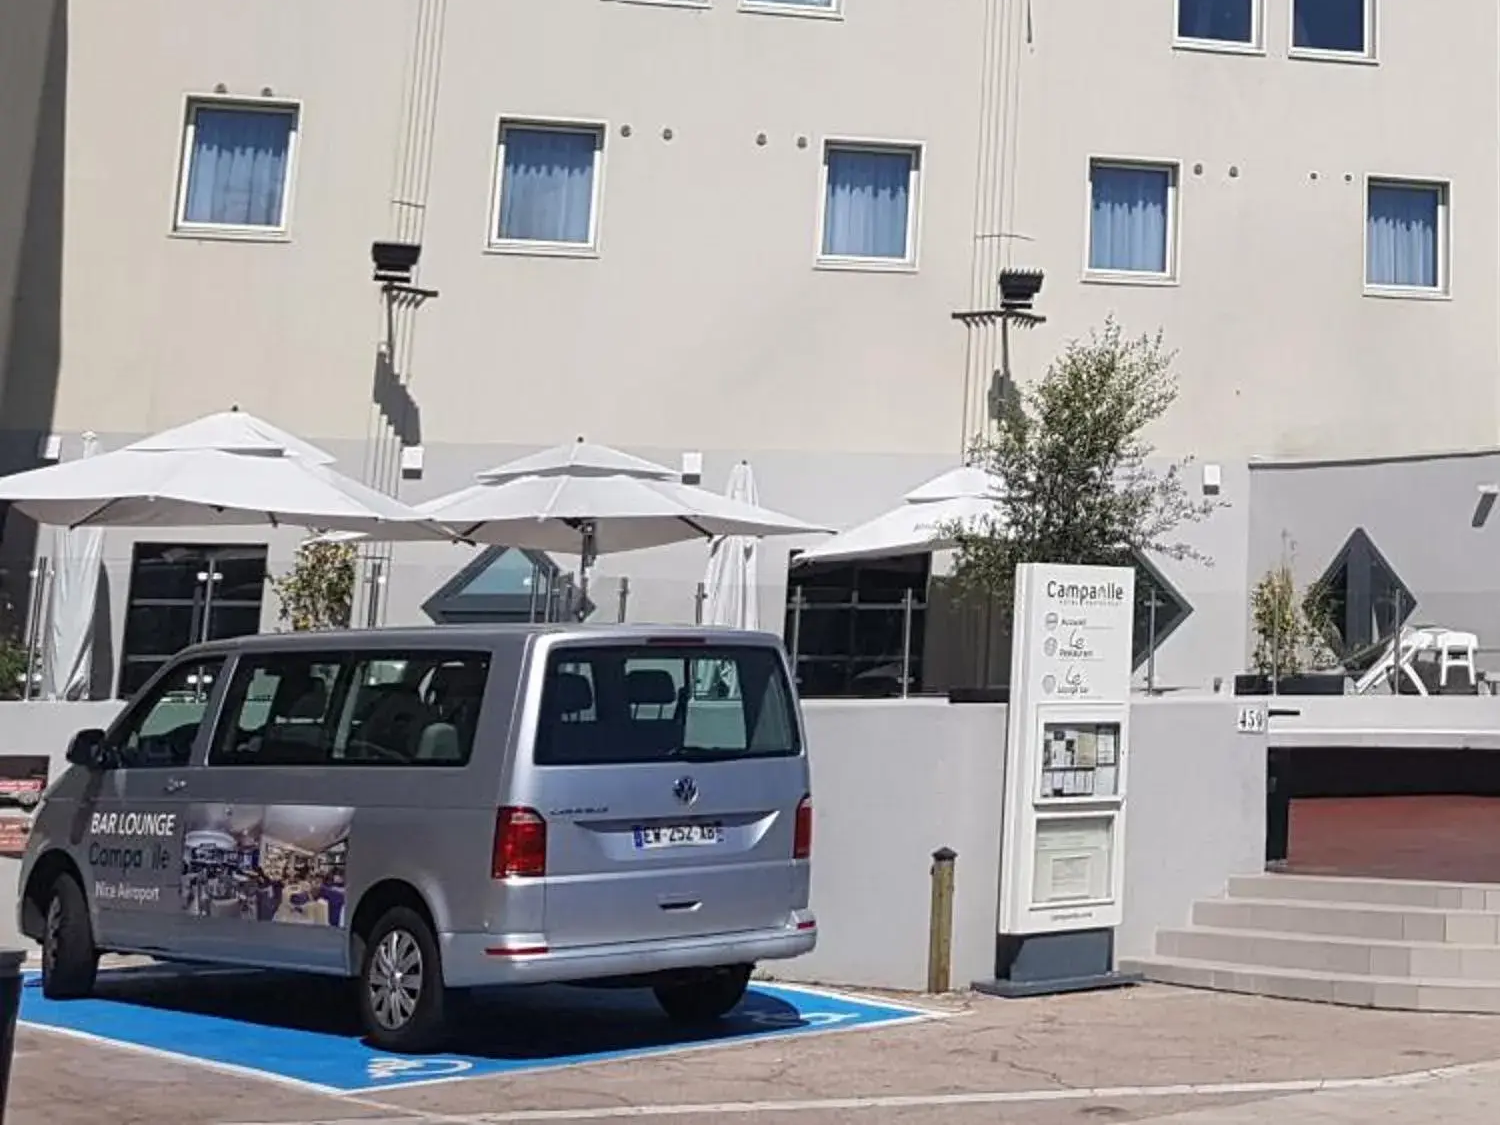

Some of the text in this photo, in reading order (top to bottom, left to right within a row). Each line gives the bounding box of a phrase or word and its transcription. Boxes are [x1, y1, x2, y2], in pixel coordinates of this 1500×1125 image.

[1239, 708, 1262, 727] 459
[91, 812, 176, 836] BAR LOUNGE
